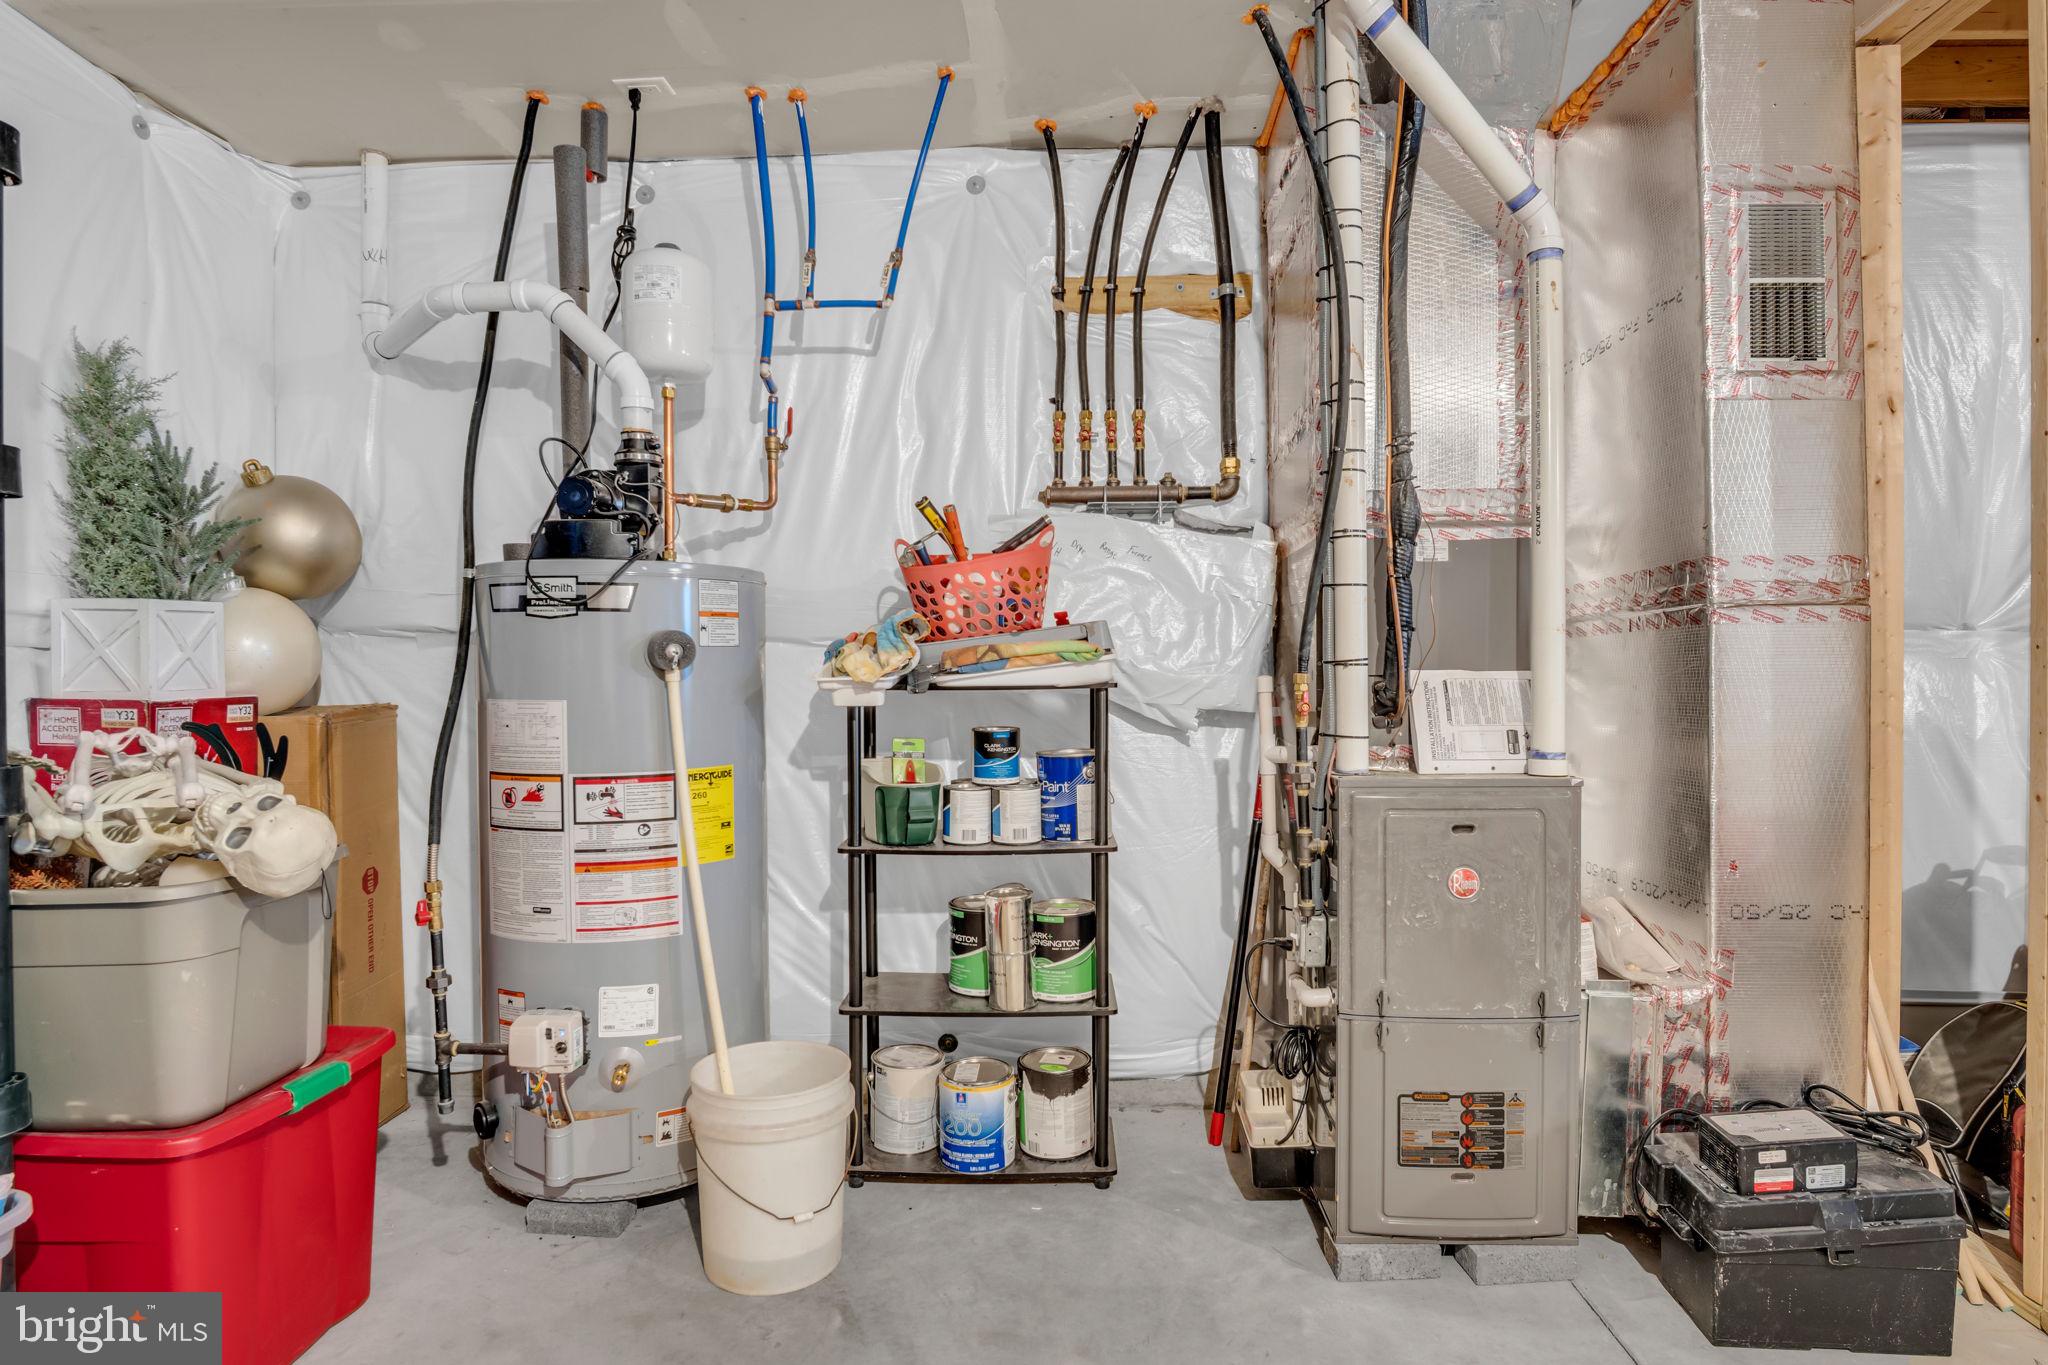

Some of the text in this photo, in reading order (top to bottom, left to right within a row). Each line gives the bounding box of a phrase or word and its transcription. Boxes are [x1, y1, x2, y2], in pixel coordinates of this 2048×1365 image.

[116, 710, 135, 721] Y32
[1423, 680, 1436, 760] INSTALLATION INSTRUCTIONS
[688, 769, 732, 783] NERGYGUIDE
[1729, 903, 1812, 920] 25/50
[367, 955, 376, 974] END
[944, 1118, 983, 1137] 200
